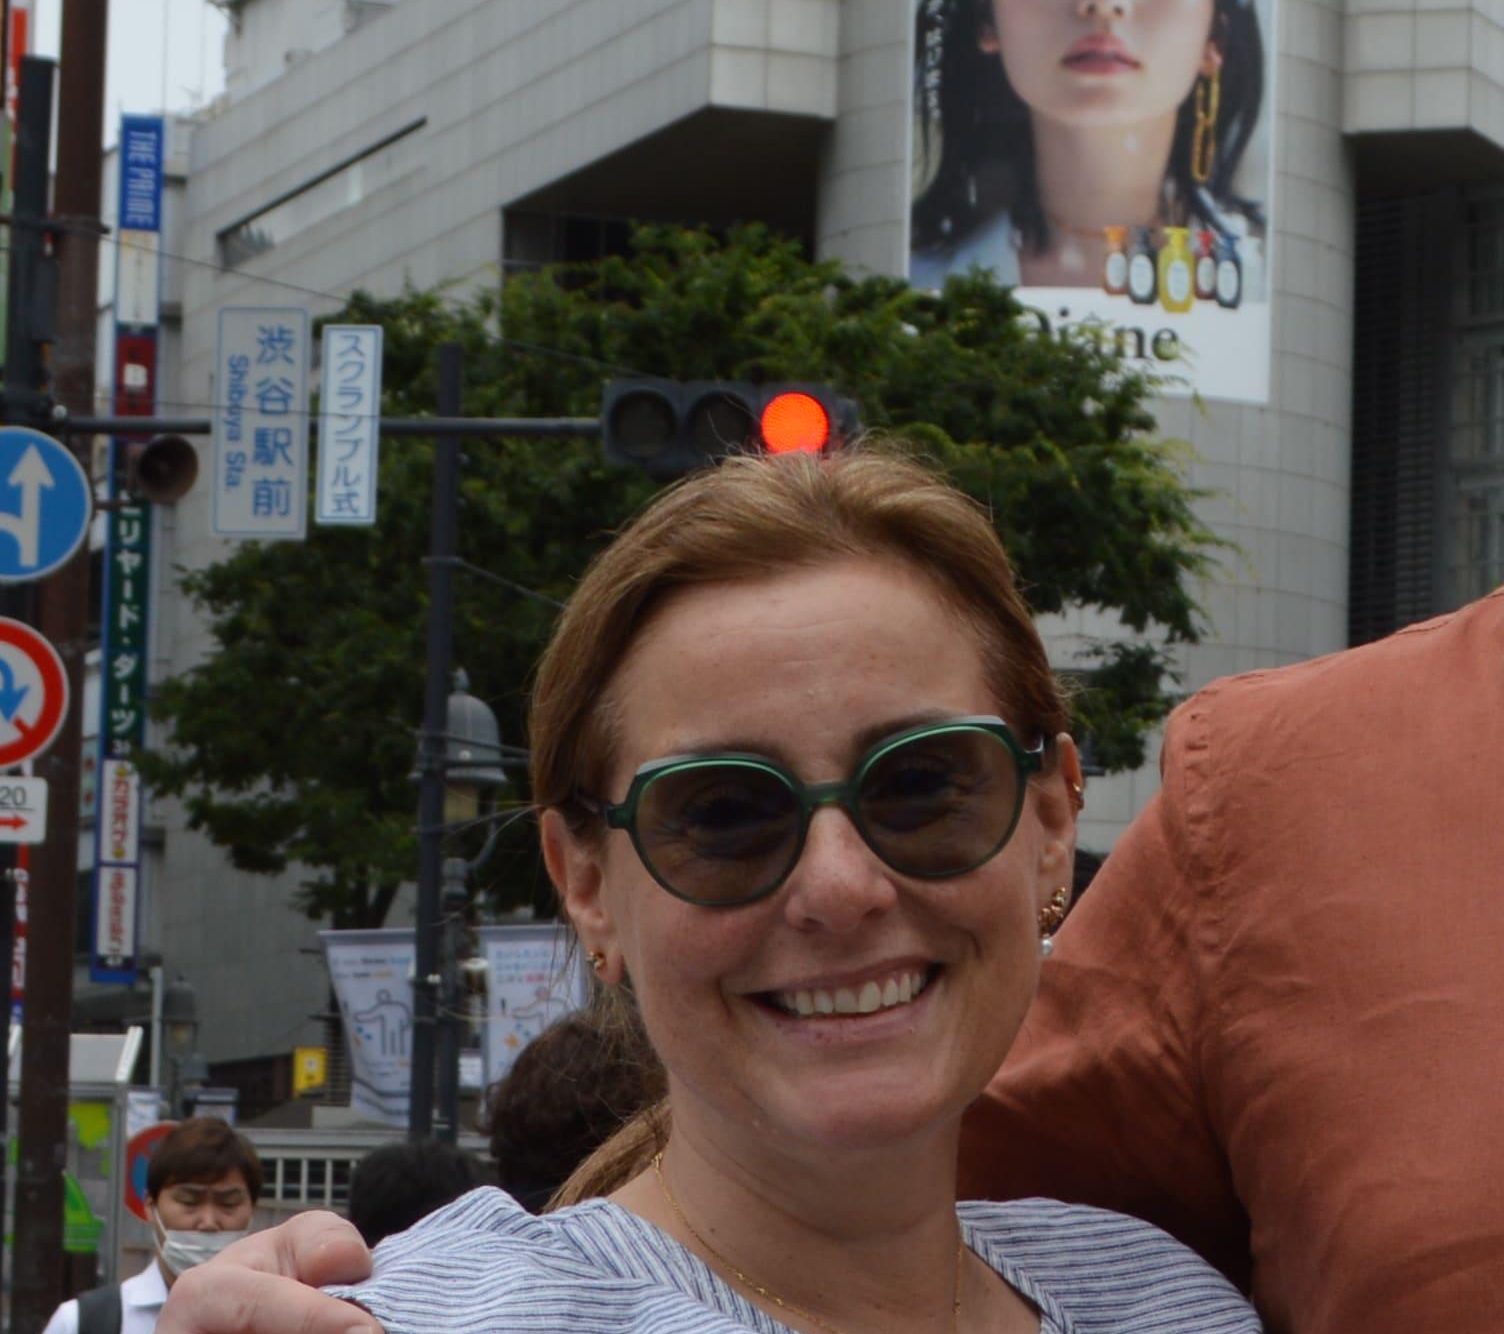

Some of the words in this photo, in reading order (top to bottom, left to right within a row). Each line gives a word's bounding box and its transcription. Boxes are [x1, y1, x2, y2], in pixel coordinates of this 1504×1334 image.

[128, 130, 157, 161] THE
[126, 166, 156, 224] PRIME
[225, 354, 249, 442] Shibuya
[252, 323, 296, 517] 渋谷駅前
